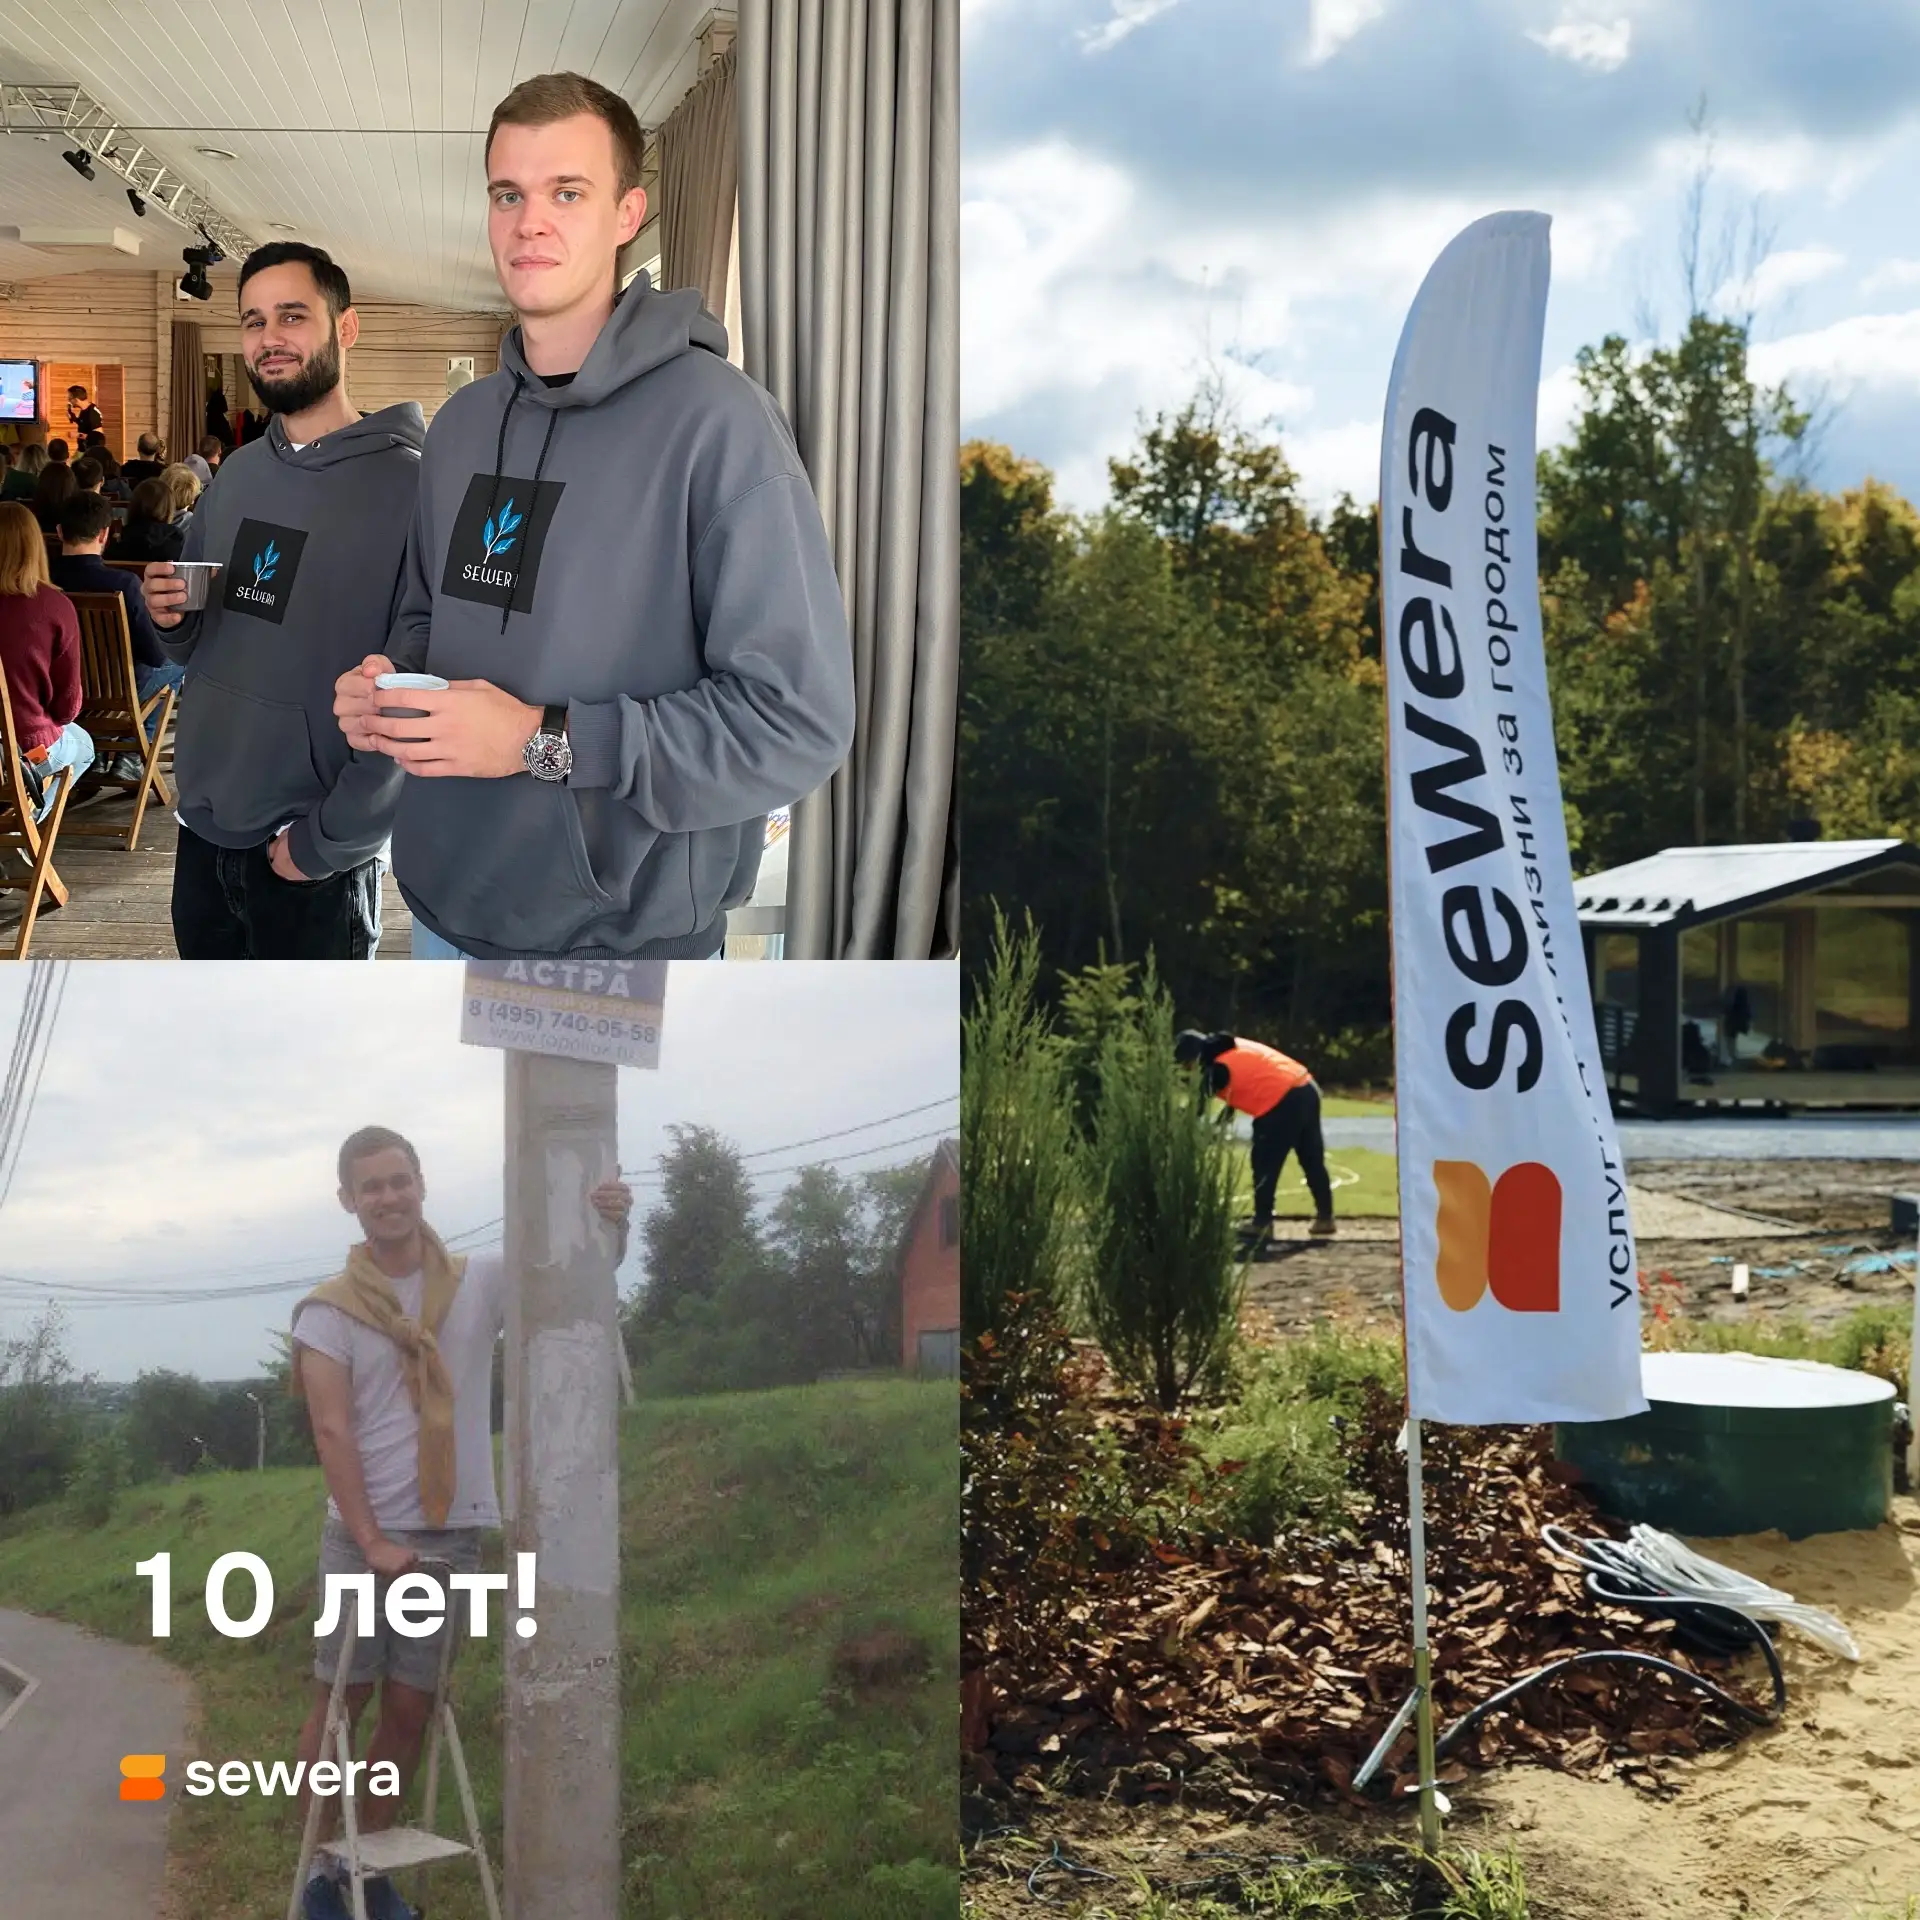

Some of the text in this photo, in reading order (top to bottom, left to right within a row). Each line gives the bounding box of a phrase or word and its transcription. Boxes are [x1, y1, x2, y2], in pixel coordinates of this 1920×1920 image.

[462, 563, 519, 589] SEWER
[1484, 443, 1519, 693] городом
[235, 585, 275, 607] SEWERA
[1400, 407, 1543, 1094] sewera
[1497, 714, 1524, 777] за
[504, 960, 631, 999] АСТРА
[468, 999, 483, 1017] 8
[488, 1003, 542, 1031] (495)
[1592, 1116, 1634, 1310] услуг
